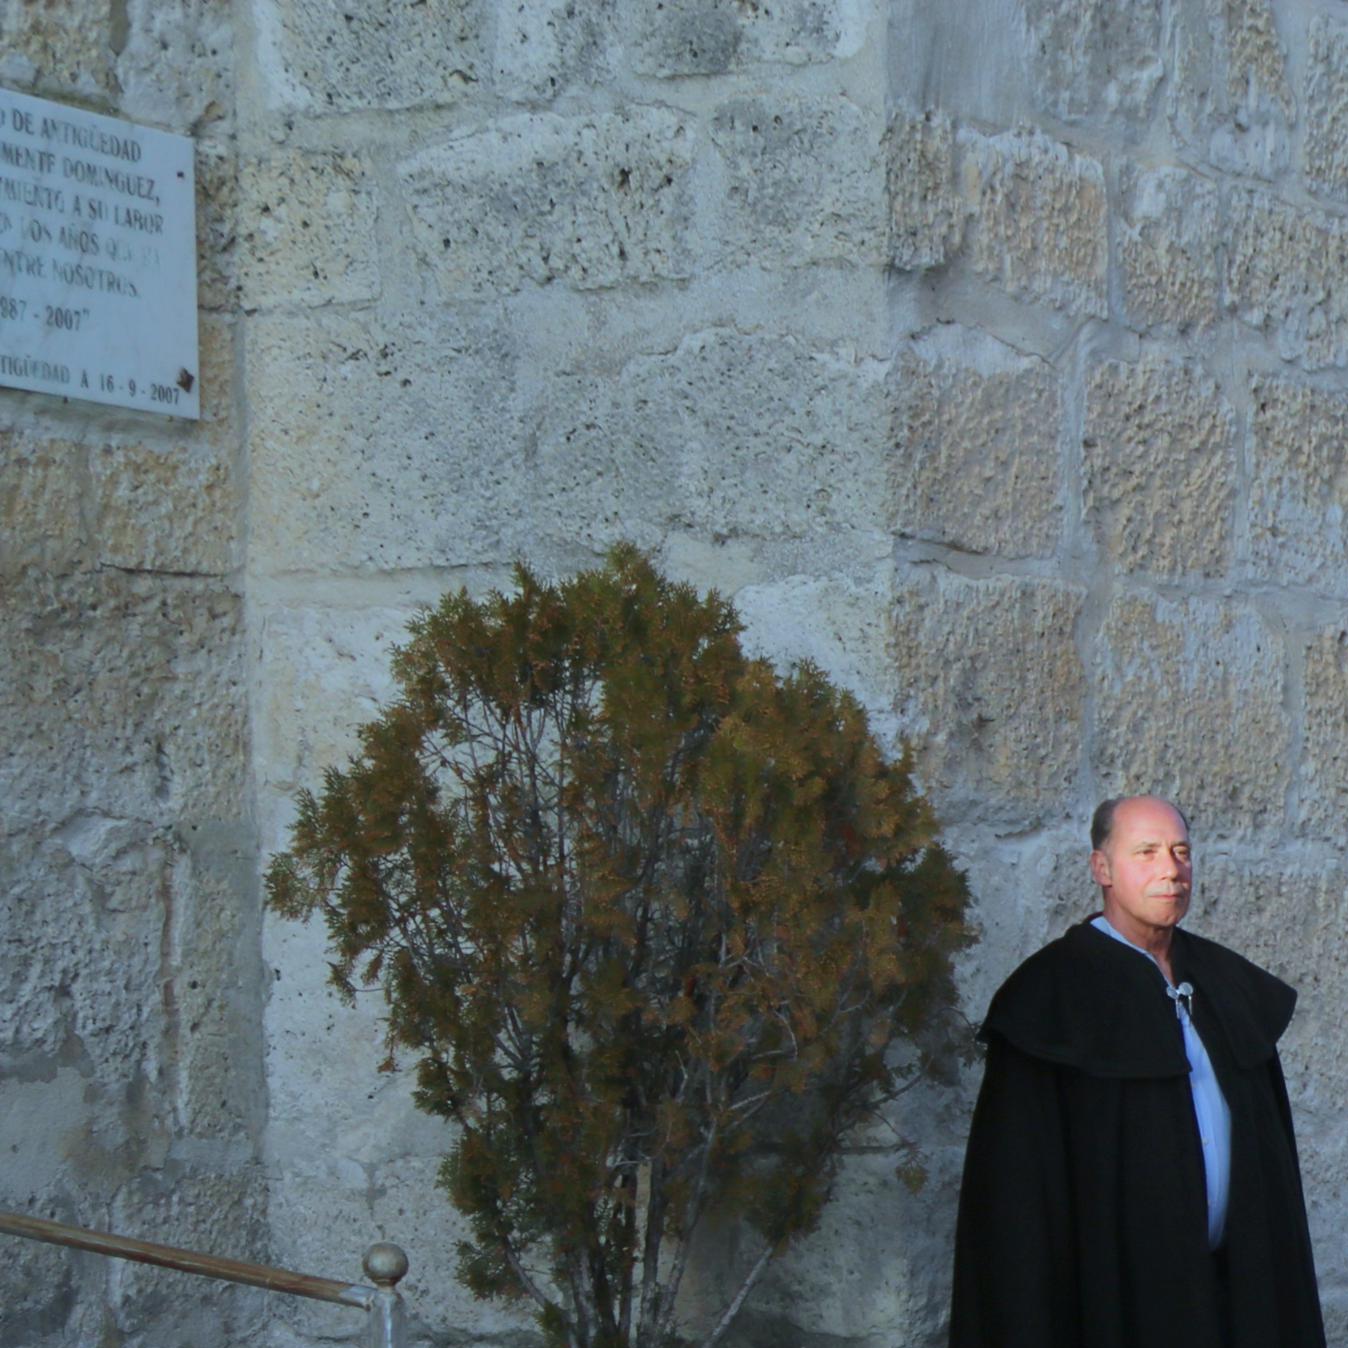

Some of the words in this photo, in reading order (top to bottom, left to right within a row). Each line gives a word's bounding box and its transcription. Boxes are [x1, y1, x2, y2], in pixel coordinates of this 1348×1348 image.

[12, 108, 35, 136] DE
[40, 116, 142, 163] ANTIGÜEDAD
[0, 175, 65, 214] MIENTO
[72, 194, 82, 218] A
[113, 204, 165, 235] LABOR
[79, 368, 90, 389] A
[149, 383, 181, 405] 2007
